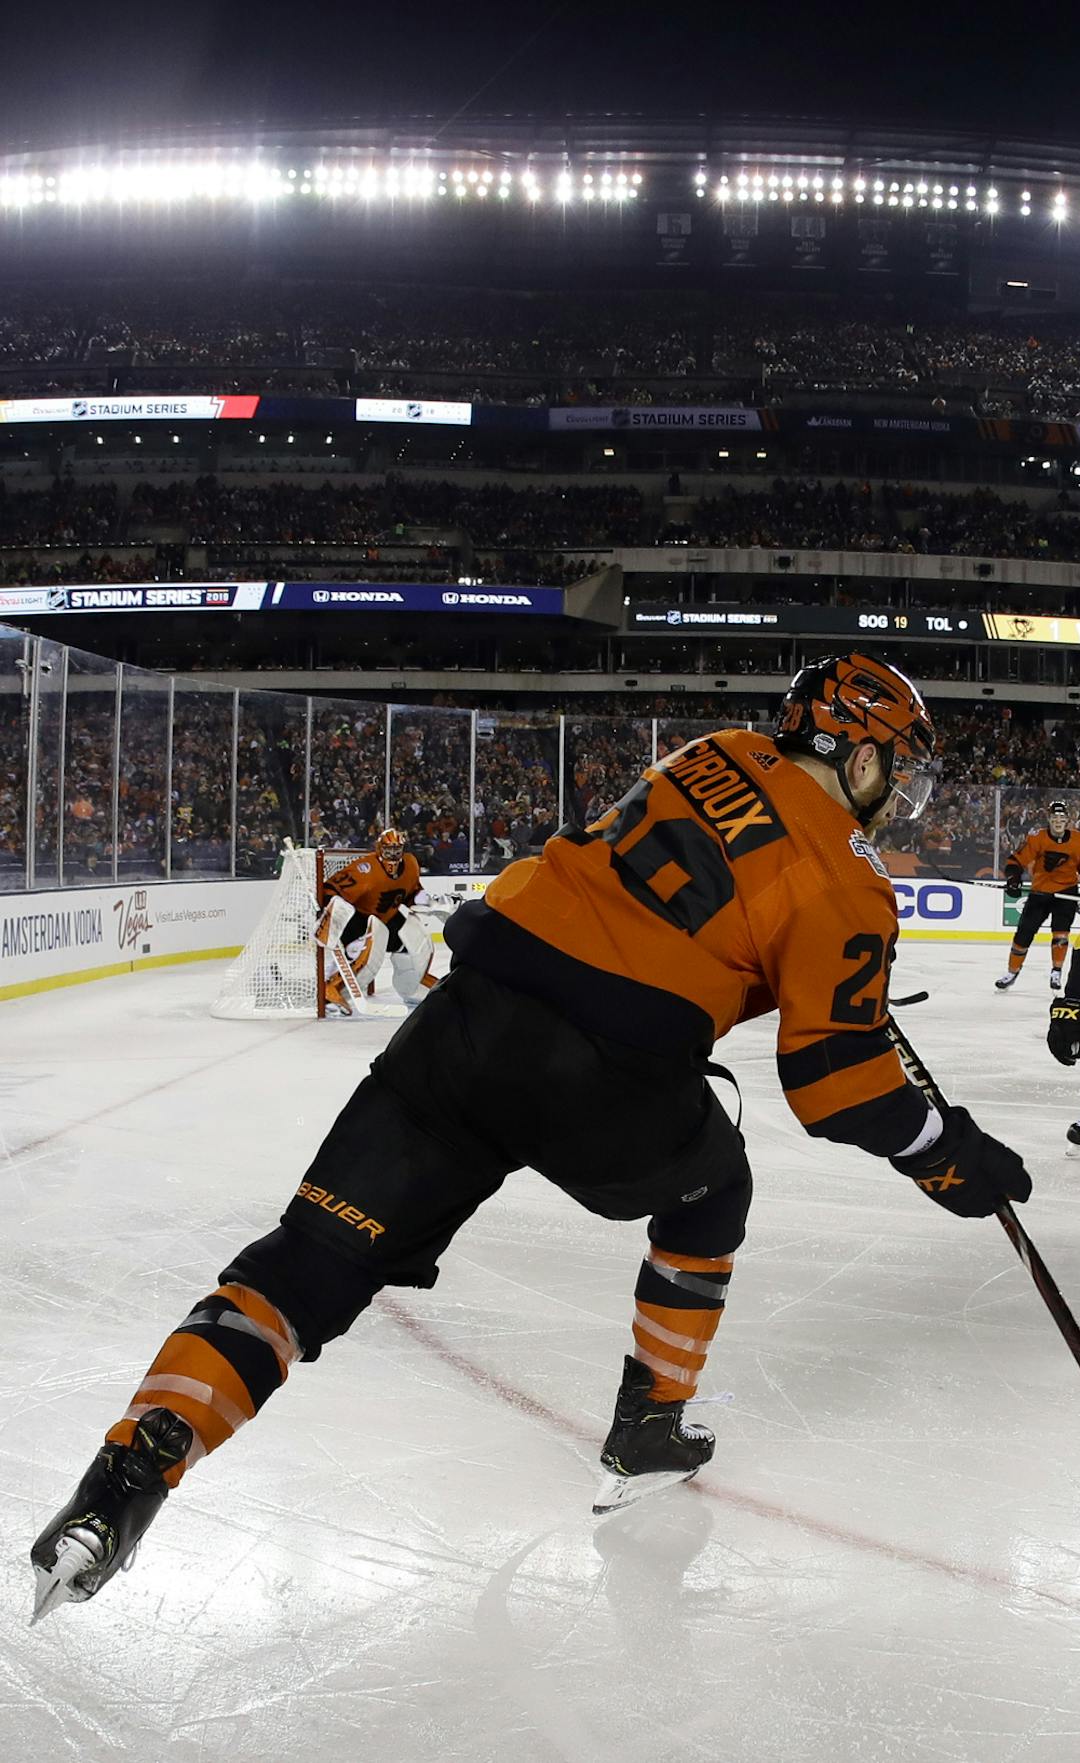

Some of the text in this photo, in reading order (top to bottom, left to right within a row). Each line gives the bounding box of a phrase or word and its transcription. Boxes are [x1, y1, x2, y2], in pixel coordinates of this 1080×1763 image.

[90, 403, 187, 415] STADIUM SERIES
[632, 414, 746, 425] STADIUM SERIES
[71, 590, 143, 608] STADIUM
[206, 592, 229, 603] 2019
[330, 591, 404, 603] HONDA
[459, 593, 532, 606] HONDA
[682, 613, 726, 624] STADIUM
[727, 614, 762, 624] SERIES
[858, 614, 908, 629] SOG 19
[926, 616, 953, 631] TOL
[667, 741, 773, 844] GIROUX
[113, 895, 153, 950] Vegas
[155, 907, 226, 924] VisitLasVegas.com
[2, 908, 104, 958] AMSTERDAM VODKA
[1051, 1006, 1080, 1022] STX
[913, 1164, 968, 1192] TX
